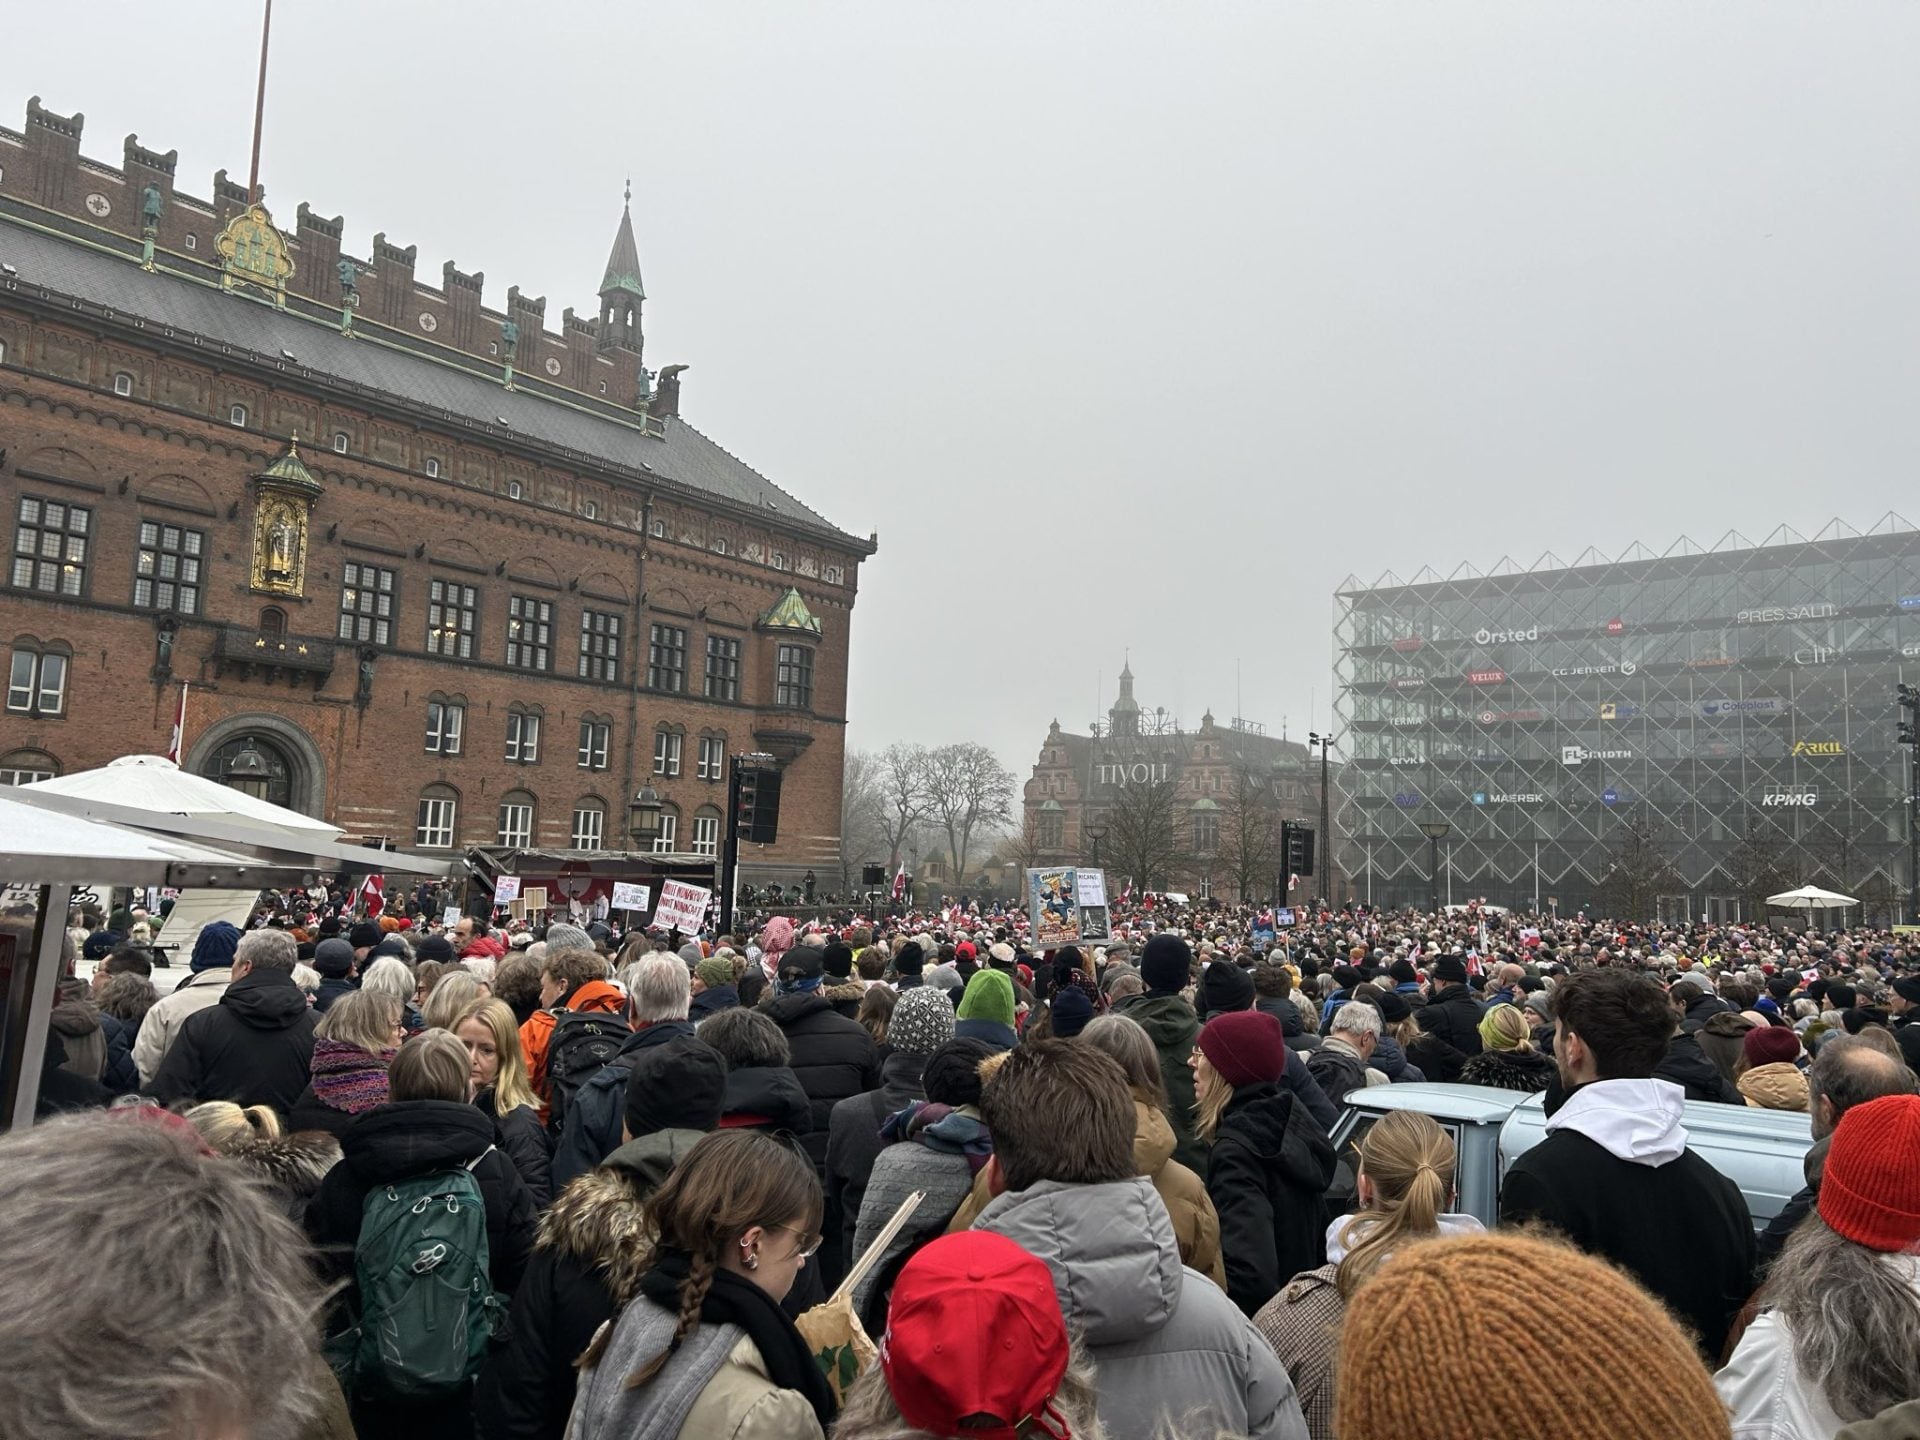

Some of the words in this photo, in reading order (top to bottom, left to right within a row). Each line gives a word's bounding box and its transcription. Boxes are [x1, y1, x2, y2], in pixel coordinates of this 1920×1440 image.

[1475, 625, 1538, 645] Ørsted
[1471, 672, 1502, 683] VELUX
[1552, 667, 1567, 676] CG
[1722, 700, 1775, 712] Coloplast
[1792, 741, 1846, 756] ARKIL
[1096, 763, 1168, 788] TIVOLI
[1490, 793, 1543, 803] MAERSK
[1762, 793, 1817, 807] KPMG
